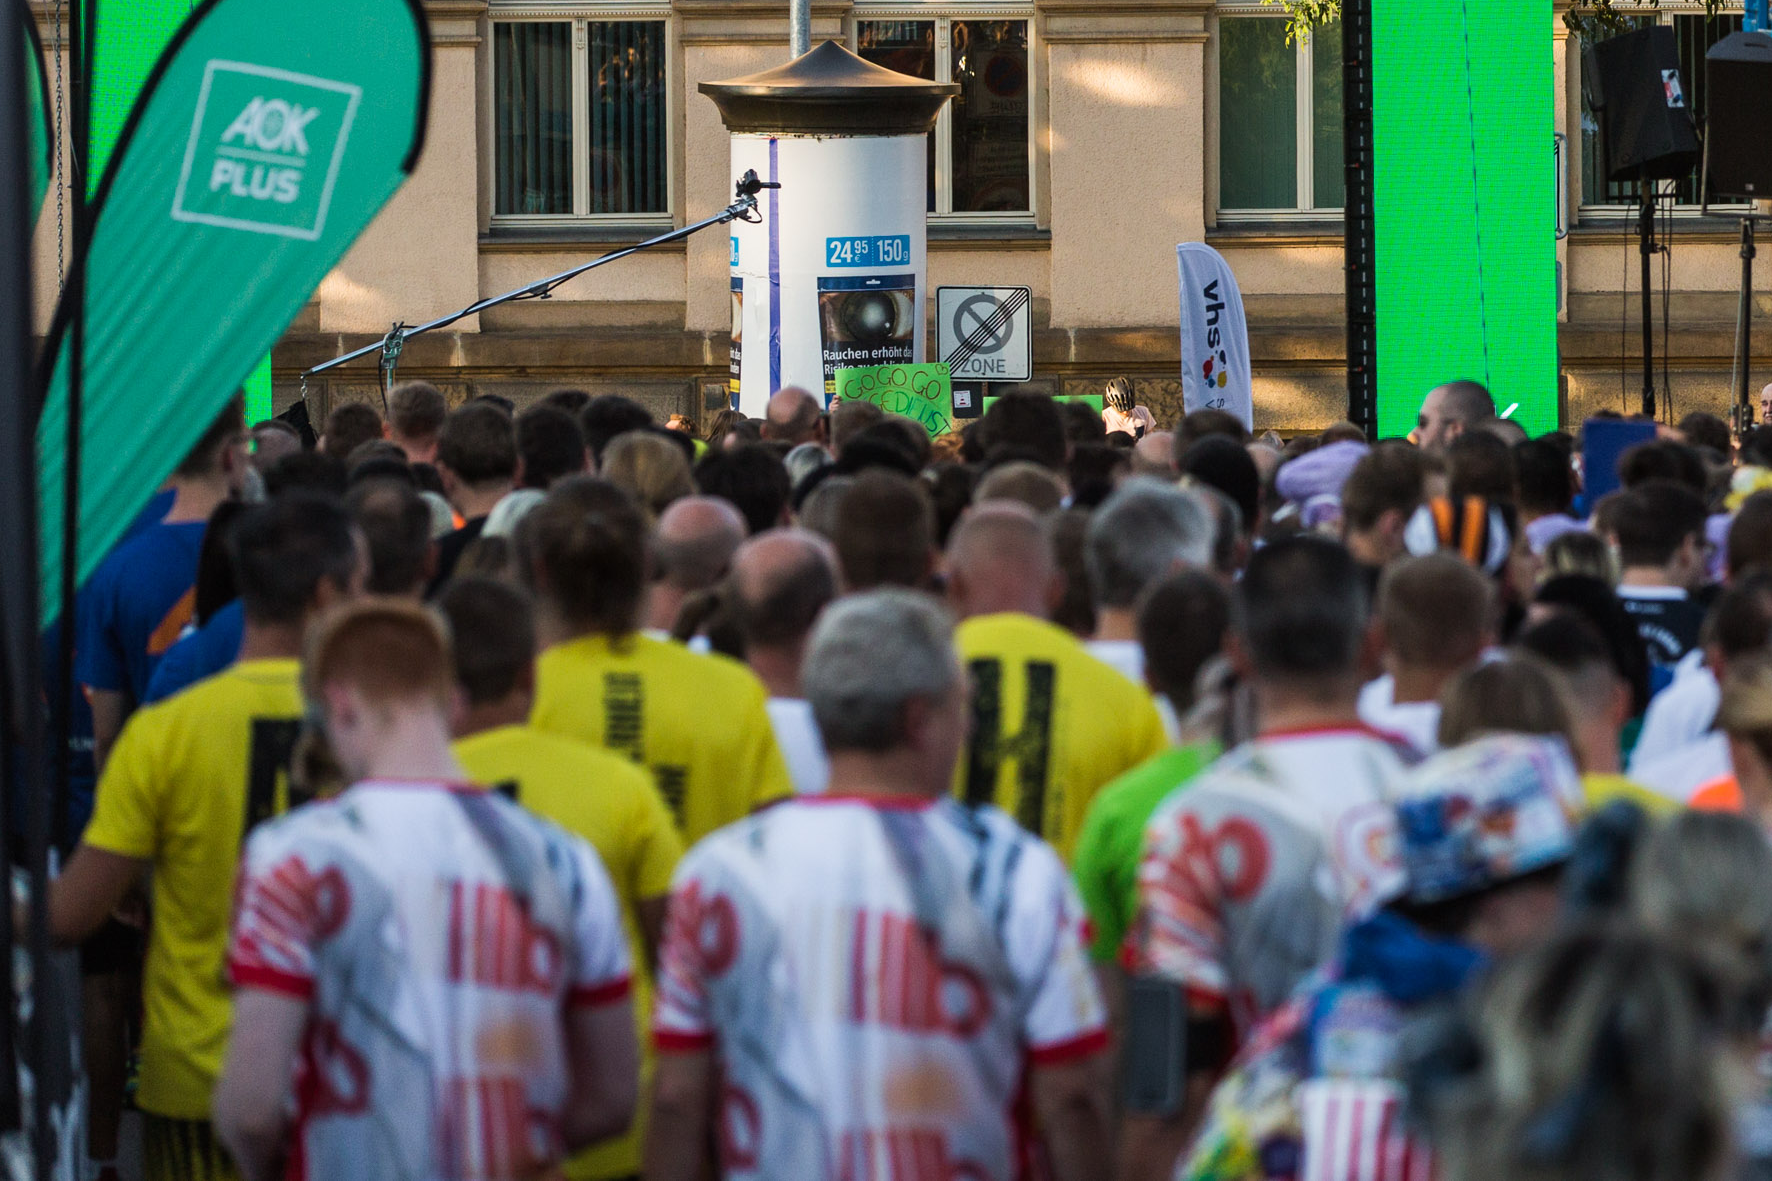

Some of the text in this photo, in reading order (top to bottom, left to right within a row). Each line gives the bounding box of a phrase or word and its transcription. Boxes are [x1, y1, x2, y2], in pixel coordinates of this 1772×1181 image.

[221, 95, 321, 154] AOK
[210, 159, 302, 203] PLUS
[1203, 279, 1225, 348] vhs
[823, 346, 913, 360] Rauchen erhöht das
[960, 359, 1006, 374] ZONE
[844, 375, 876, 399] GO
[876, 366, 907, 387] GO
[911, 370, 942, 400] GO
